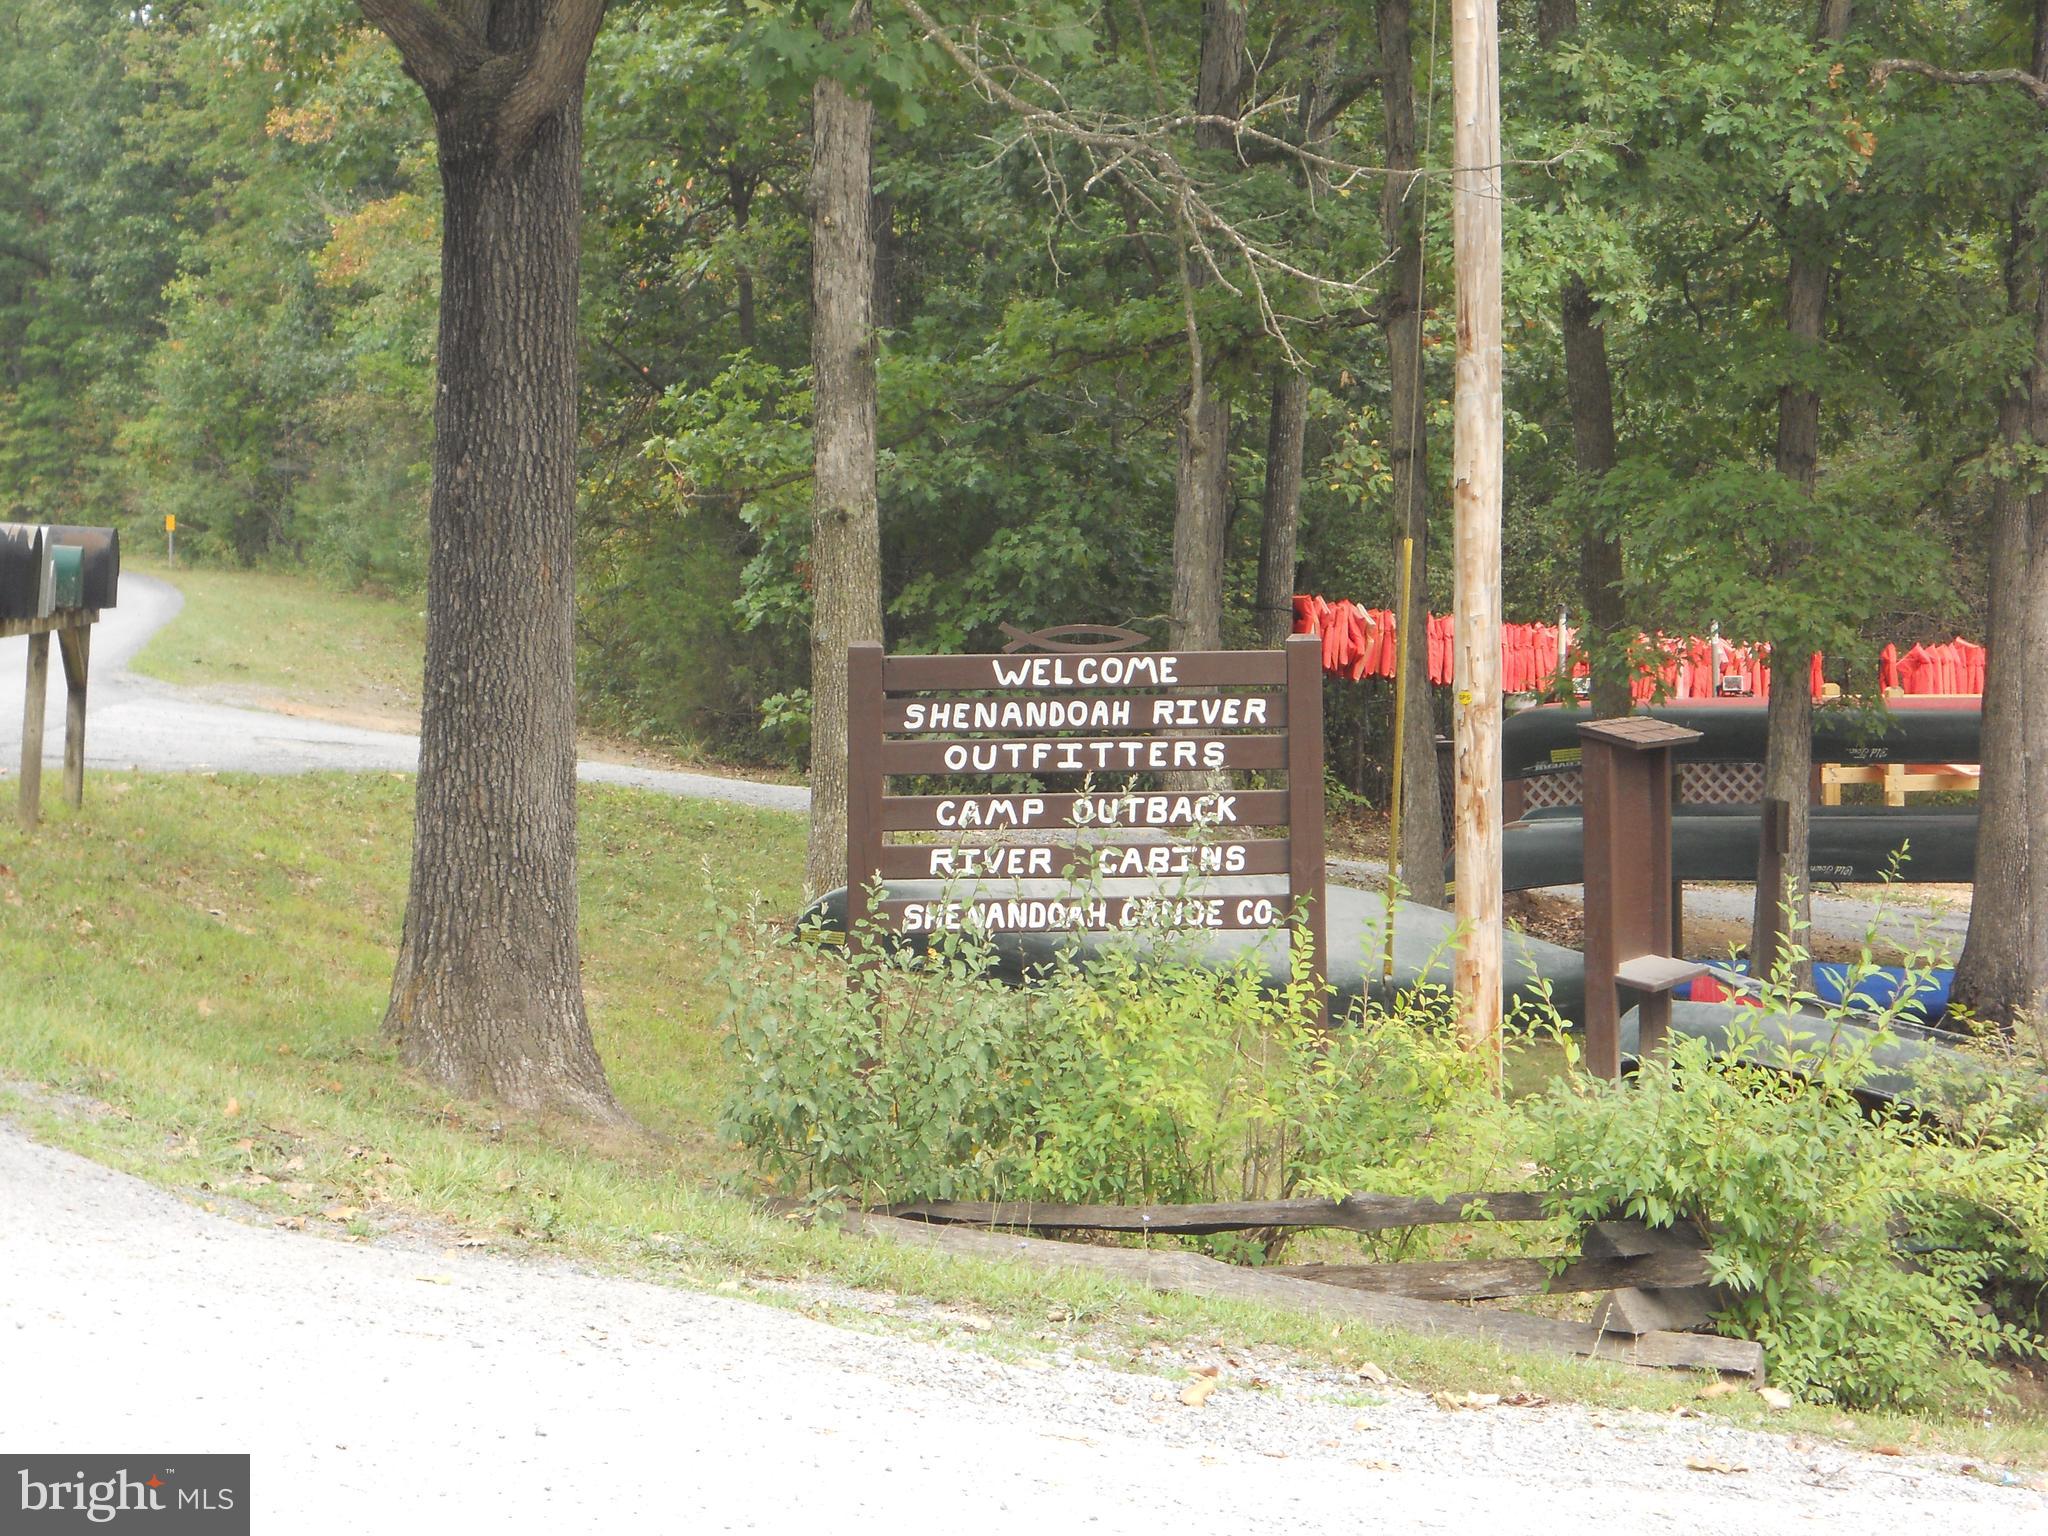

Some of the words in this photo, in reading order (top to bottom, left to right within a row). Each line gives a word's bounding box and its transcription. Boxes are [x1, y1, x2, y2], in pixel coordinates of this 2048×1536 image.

[992, 657, 1178, 686] WELCOME
[903, 699, 1130, 729] SHENANDOAH
[1152, 698, 1267, 725] RIVER
[944, 741, 1226, 771] OUTFITTERS
[936, 798, 1045, 826] CAMP
[1072, 796, 1237, 823] OUTBACK
[929, 848, 1052, 875] RIVER
[1098, 845, 1247, 874] CABINS
[903, 902, 1107, 930] SHENANDOAH
[1236, 899, 1278, 926] CO.
